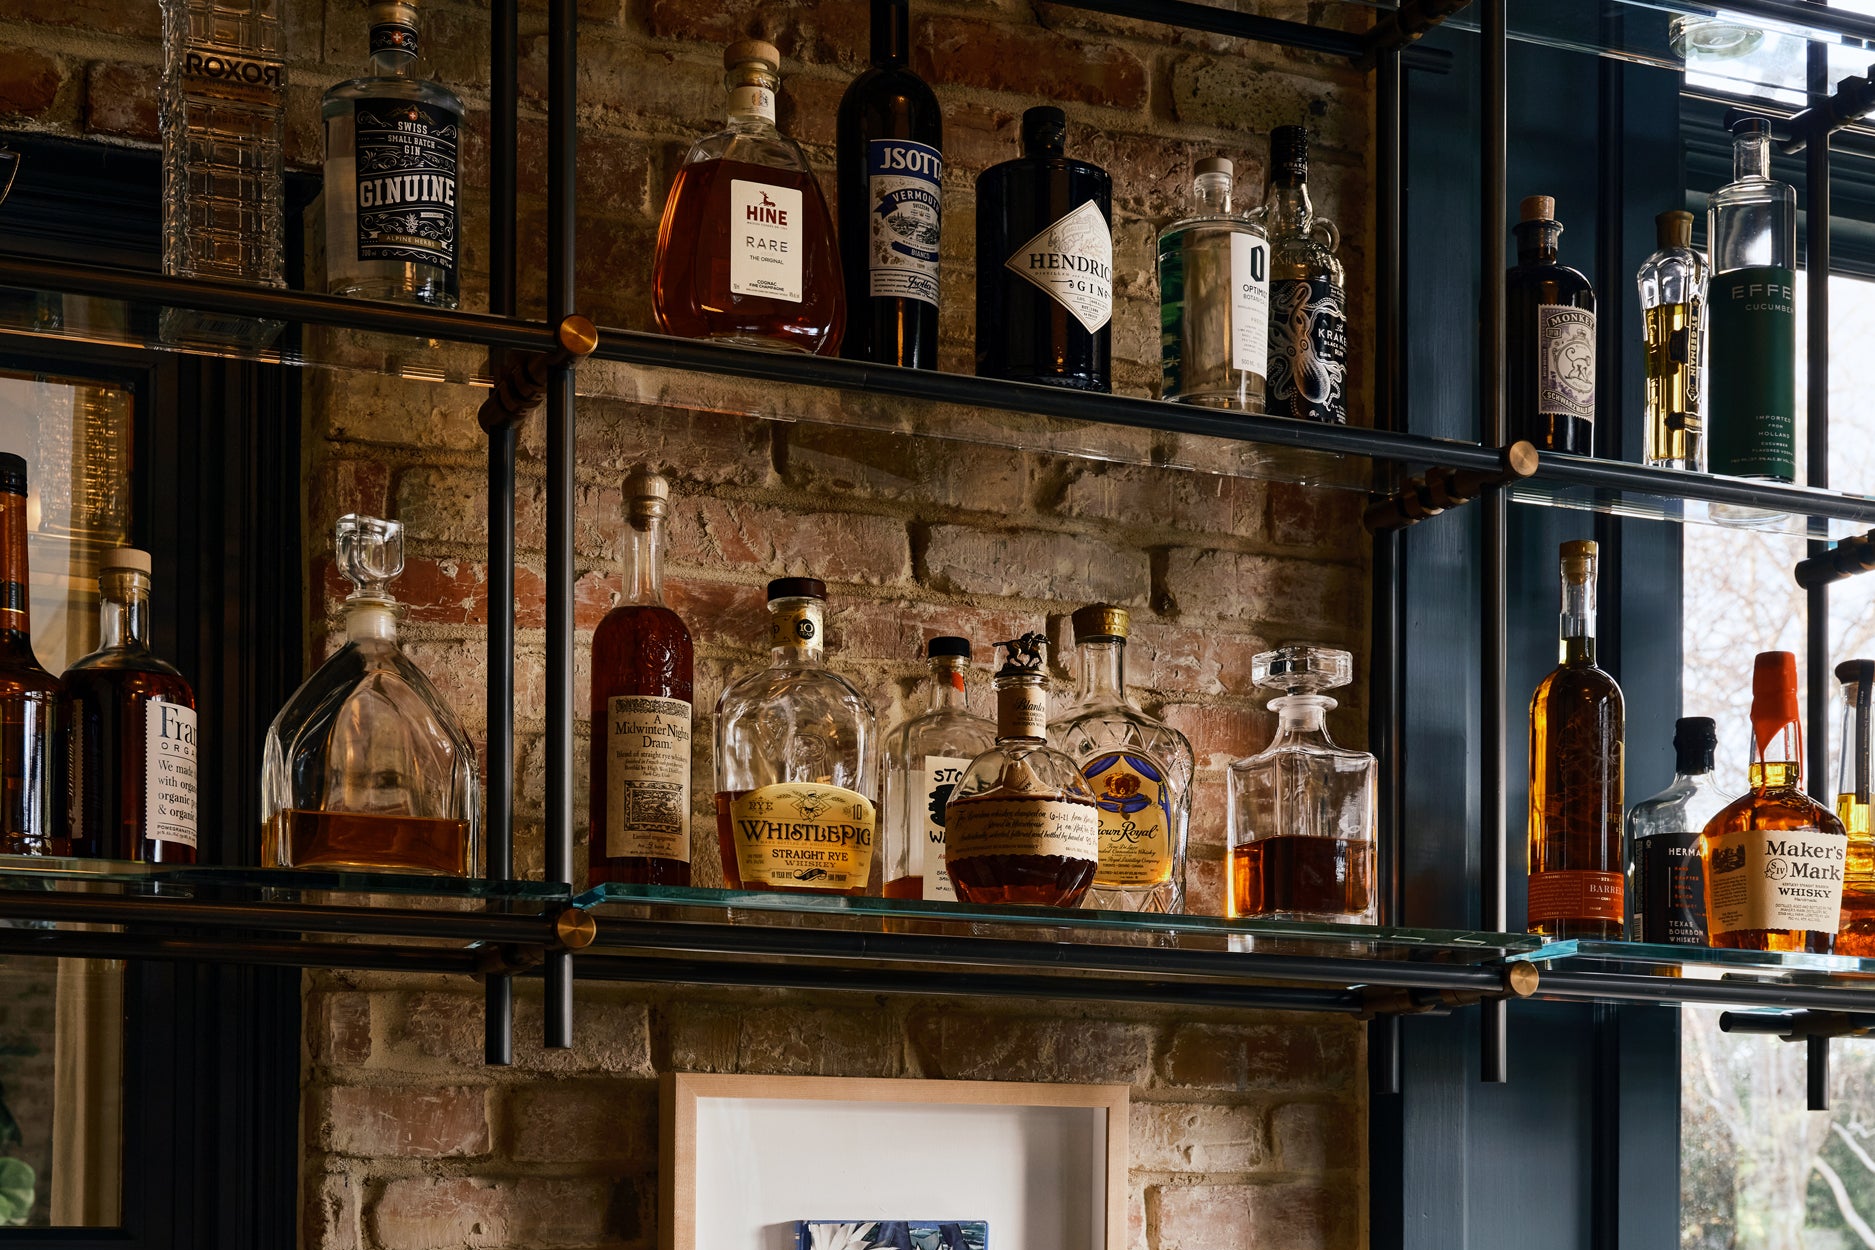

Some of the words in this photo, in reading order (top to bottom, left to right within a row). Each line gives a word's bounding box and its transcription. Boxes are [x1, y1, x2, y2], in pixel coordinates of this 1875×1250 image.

[186, 53, 281, 87] ROXOR
[397, 121, 428, 135] SWISS
[387, 134, 412, 144] SMALL
[413, 137, 436, 149] BATCH
[404, 145, 421, 156] GIN
[360, 174, 455, 208] GINUINE
[746, 204, 788, 226] HINE
[386, 234, 412, 243] ALPINE
[414, 239, 435, 248] HERBS
[746, 236, 788, 253] RARE
[749, 254, 760, 262] THE
[760, 257, 784, 265] ORIGINAL
[1077, 280, 1104, 297] GIN
[1690, 315, 1698, 377] ST-GERMAIN
[1755, 415, 1791, 423] IMPORTED
[1758, 431, 1790, 439] HOLLAND
[799, 623, 813, 632] 10
[654, 714, 661, 724] A
[615, 721, 666, 735] Midwinter
[158, 759, 173, 771] We
[176, 763, 194, 776] made
[158, 776, 178, 787] with
[158, 792, 190, 806] organic
[748, 801, 773, 810] RYE
[158, 804, 167, 815] &
[170, 808, 194, 821] organic
[852, 803, 862, 820] 10
[1111, 820, 1158, 843] Royal
[772, 849, 826, 860] STRAIGHT
[828, 851, 849, 861] RYE
[1765, 840, 1843, 860] Maker's
[785, 860, 836, 868] WHISKEY
[1790, 862, 1841, 880] Mark
[1778, 887, 1831, 898] WHISKY
